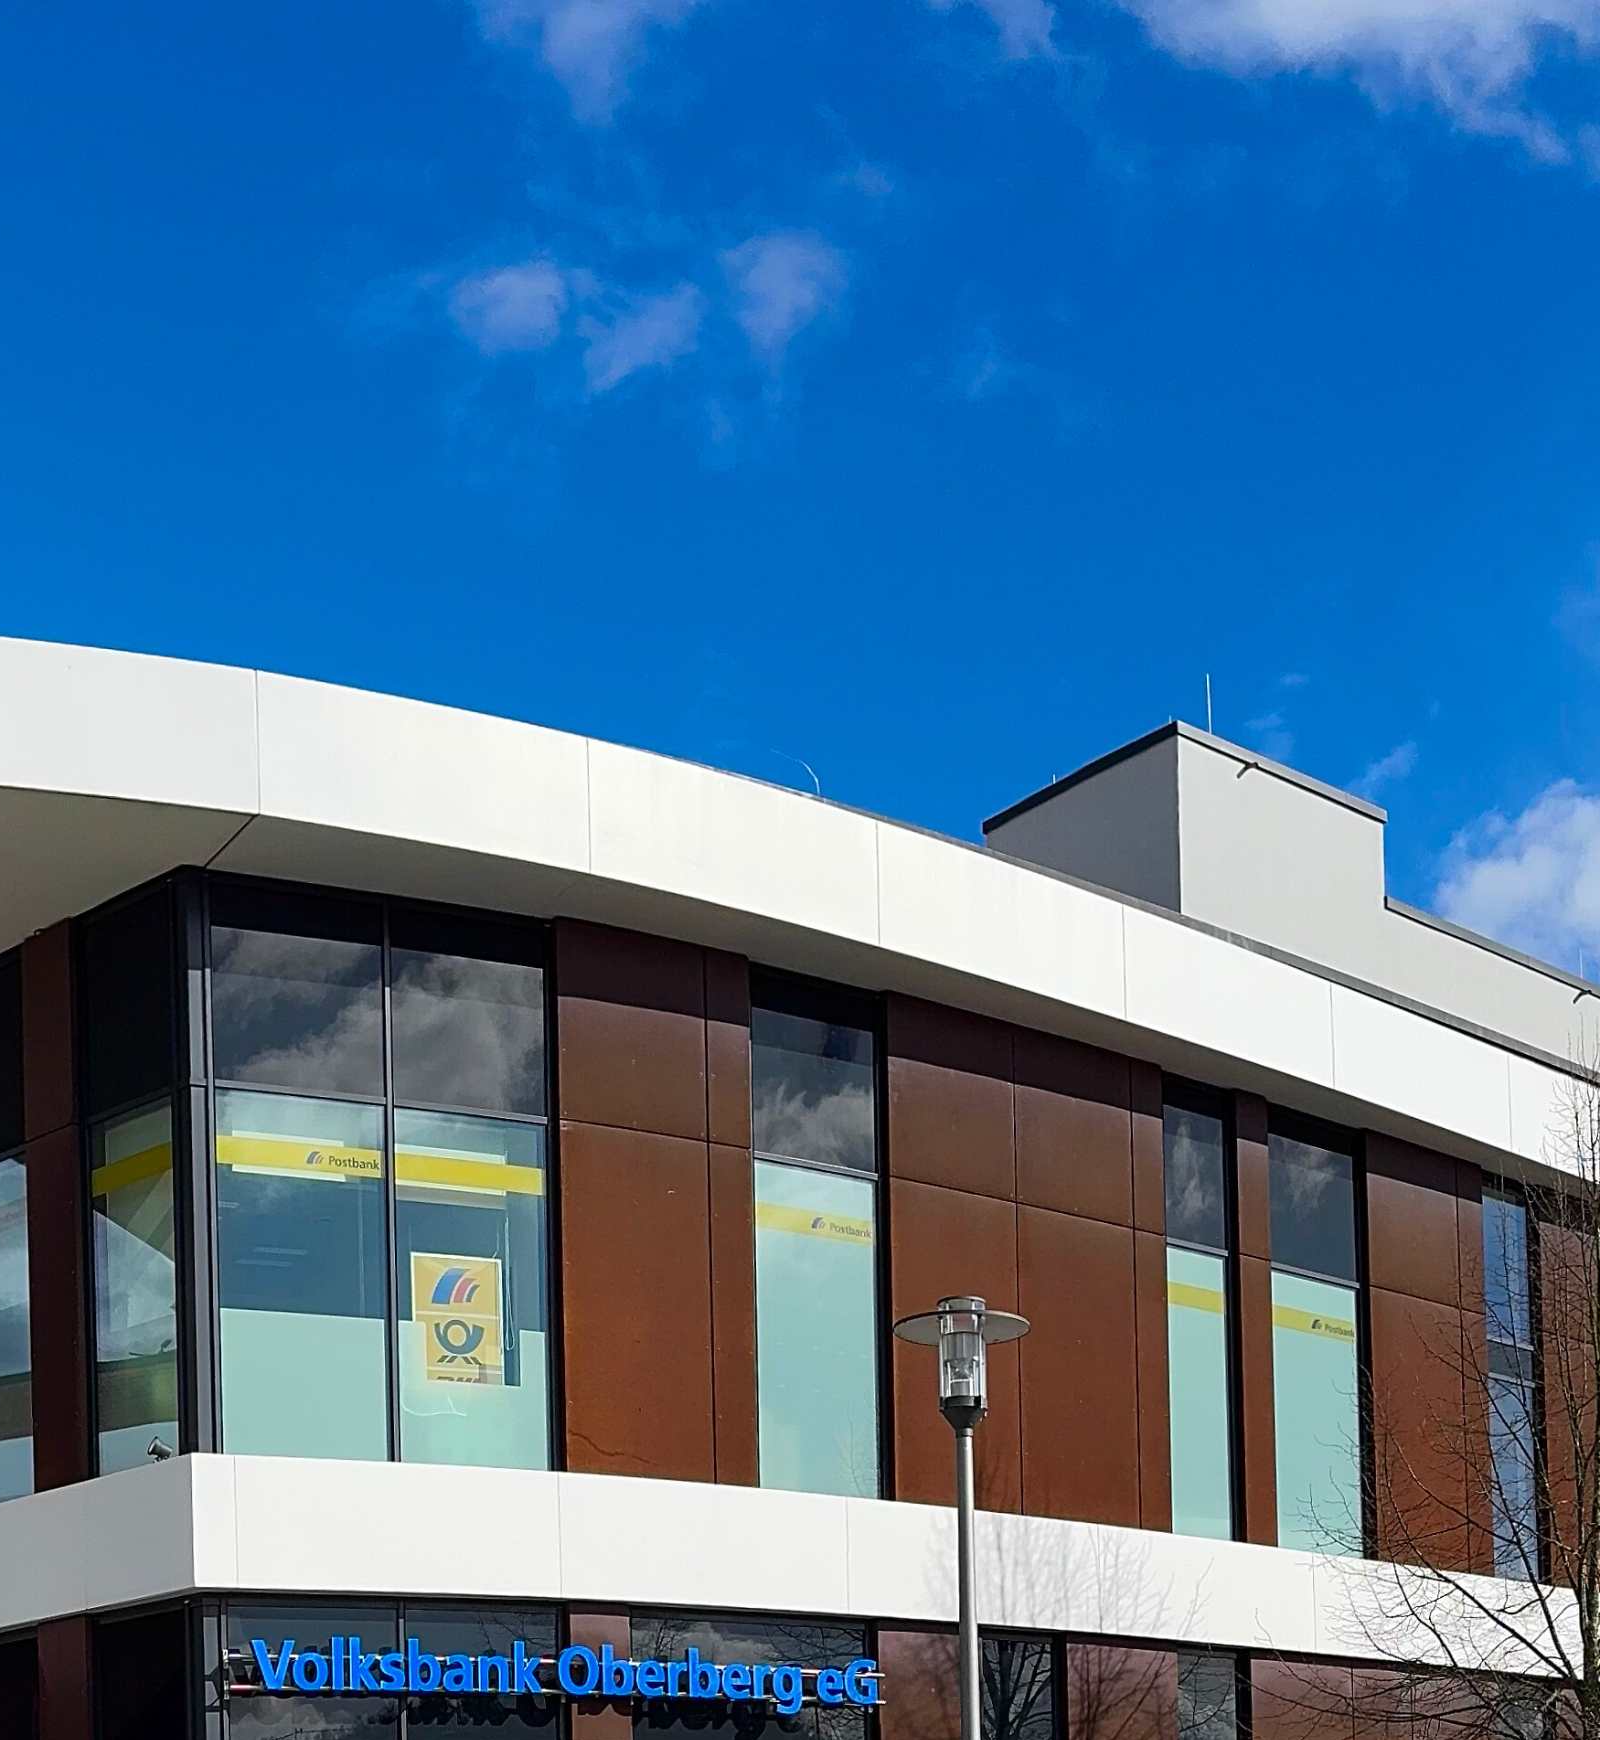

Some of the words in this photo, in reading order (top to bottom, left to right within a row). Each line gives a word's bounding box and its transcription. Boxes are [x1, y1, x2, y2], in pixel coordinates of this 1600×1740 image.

[328, 1155, 381, 1171] Postbank
[829, 1222, 873, 1238] Postbank
[250, 1637, 544, 1694] Volksbank
[556, 1643, 802, 1714] Oberberg
[816, 1659, 879, 1705] eG
